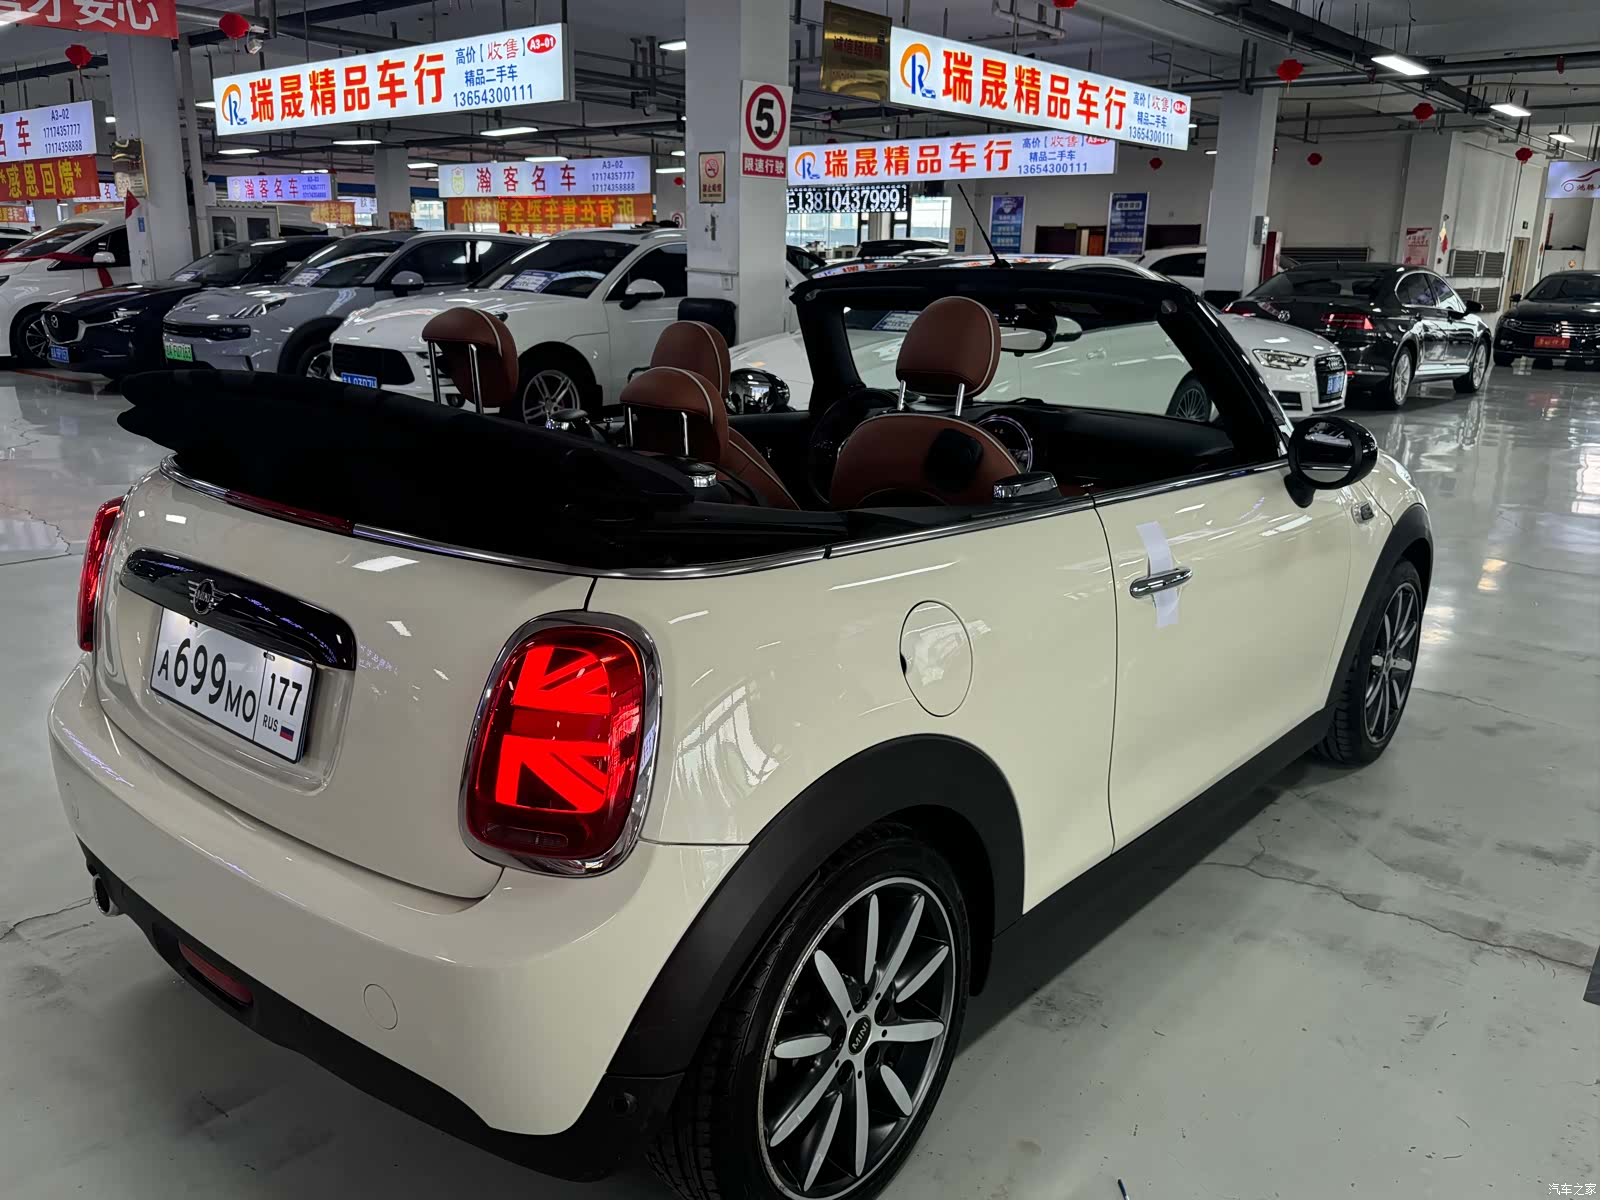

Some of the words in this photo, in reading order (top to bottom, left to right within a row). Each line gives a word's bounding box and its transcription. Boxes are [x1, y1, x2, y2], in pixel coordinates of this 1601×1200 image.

[529, 38, 554, 50] A3-01
[464, 64, 518, 87] 精品二手车
[249, 53, 446, 123] 瑞晟精品车行
[453, 83, 533, 107] 13654300111
[941, 49, 1127, 131] 瑞晟精品车行
[51, 108, 70, 121] A3-02
[754, 97, 775, 139] 5
[1136, 111, 1167, 128] 精品二手车
[43, 123, 81, 138] 17174357777
[1129, 126, 1173, 145] 13654300111
[45, 140, 83, 154] 17174358888
[824, 140, 1013, 178] 瑞晟精品车行
[1029, 150, 1076, 162] 精品二手车
[602, 160, 623, 170] A3-02
[744, 157, 784, 174] 限速行驶
[1018, 162, 1088, 175] 13654300111
[476, 164, 577, 193] 瀚客名车
[592, 171, 635, 182] 17174357777
[592, 183, 635, 193] 17174358888
[268, 672, 303, 716] 177
[262, 714, 279, 732] RUS
[852, 1022, 869, 1049] MINI
